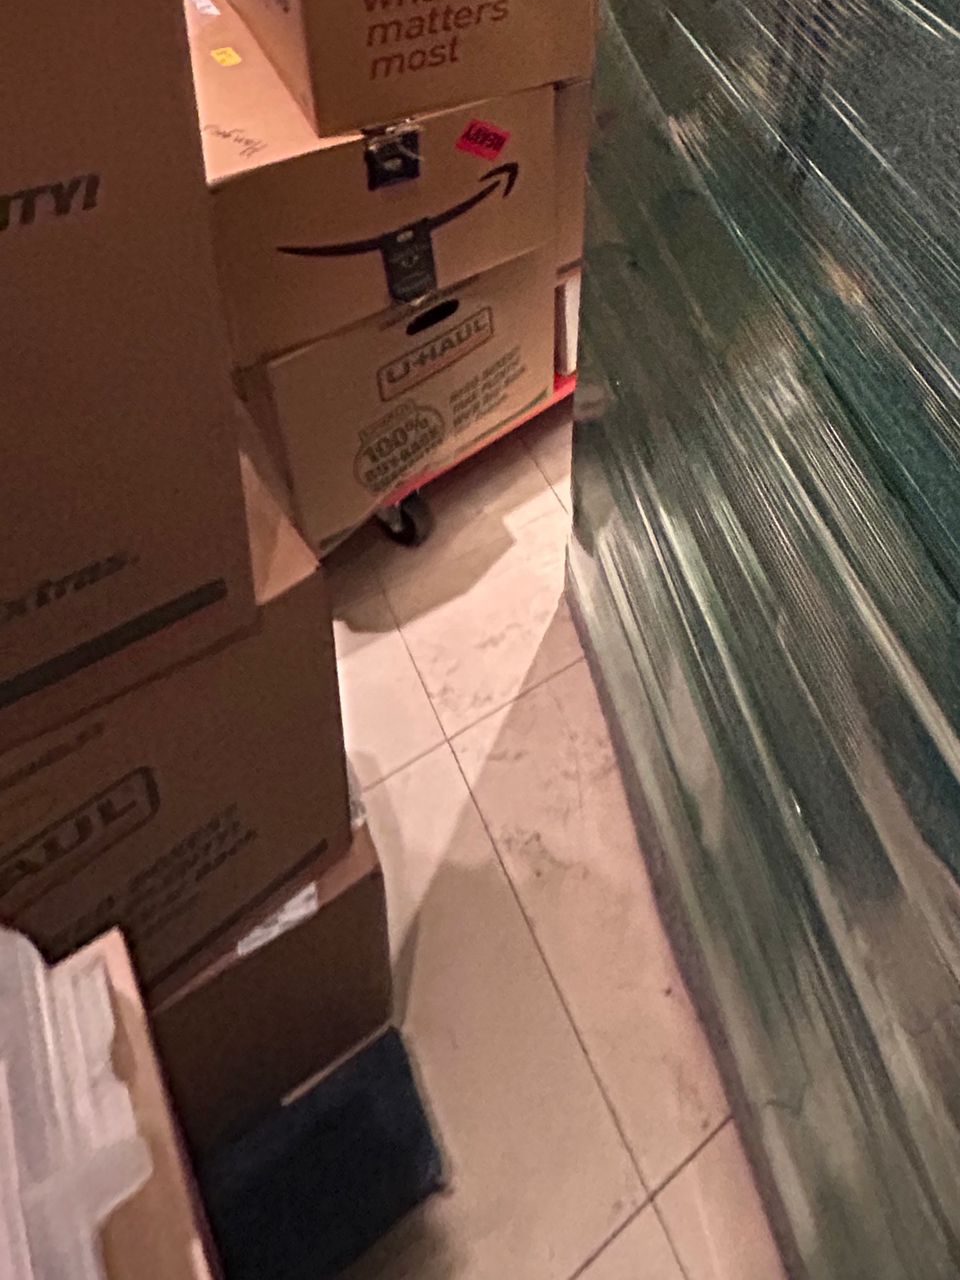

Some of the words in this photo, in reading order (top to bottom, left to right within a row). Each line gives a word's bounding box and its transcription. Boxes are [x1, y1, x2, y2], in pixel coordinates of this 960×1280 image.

[370, 36, 461, 81] most
[387, 316, 488, 383] U-HAUL
[364, 417, 429, 464] 100%
